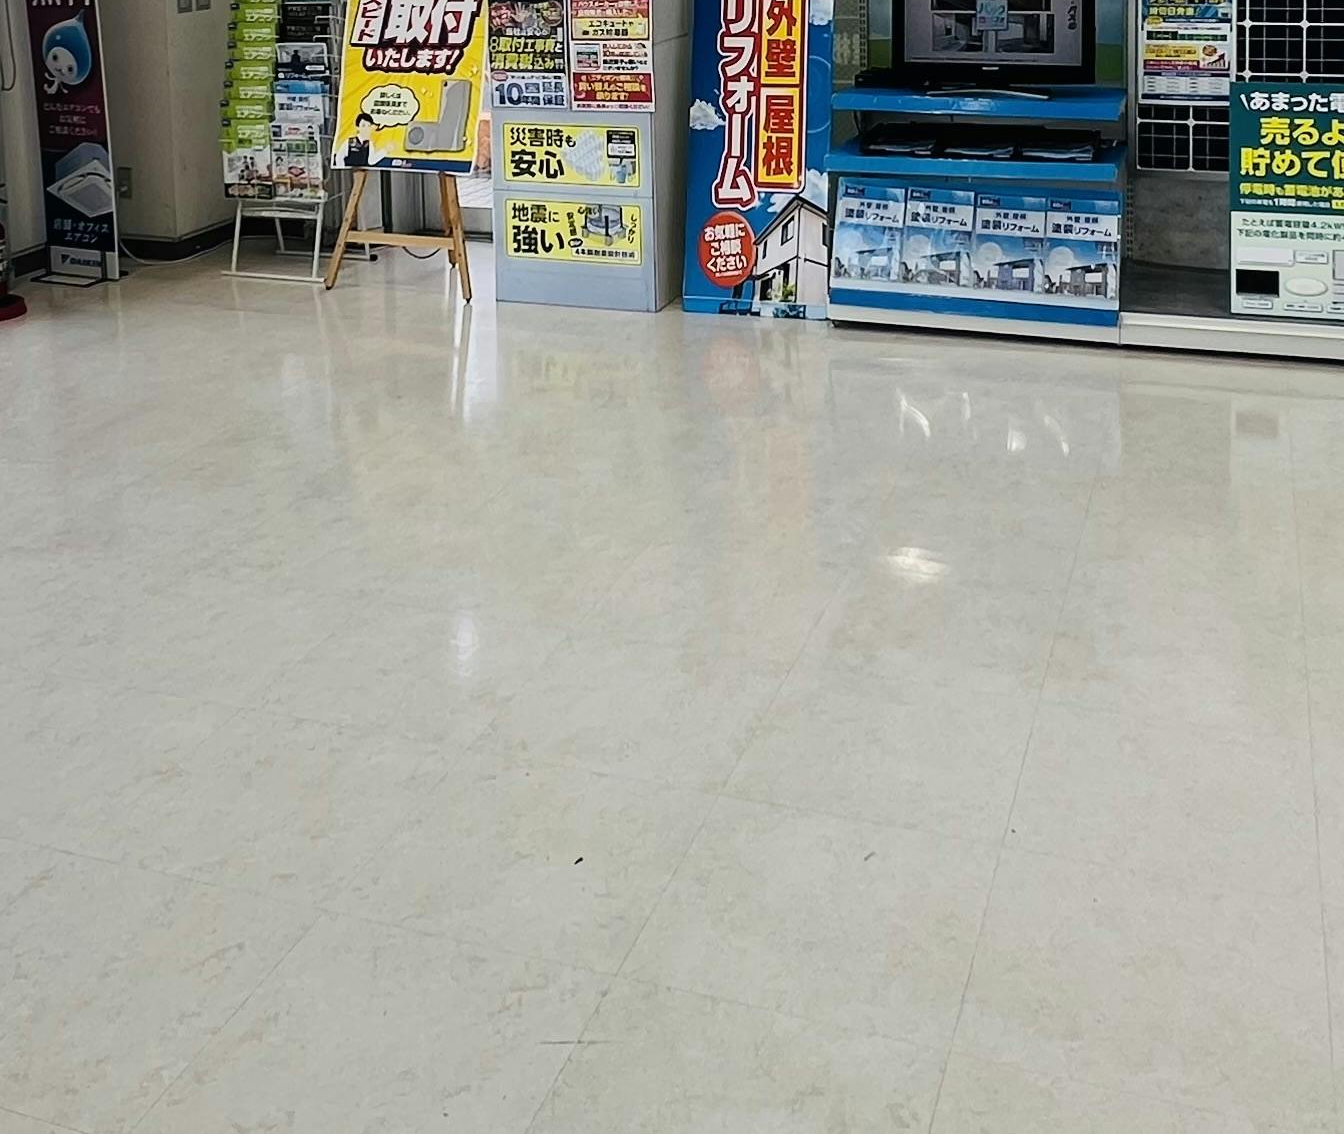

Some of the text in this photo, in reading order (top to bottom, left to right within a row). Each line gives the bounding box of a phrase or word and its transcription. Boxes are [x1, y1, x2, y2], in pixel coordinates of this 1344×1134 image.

[365, 48, 460, 70] いたします!
[510, 127, 577, 148] 災害時も
[762, 94, 795, 177] 屋根
[511, 149, 565, 179] 安心
[512, 203, 560, 224] 地震に
[65, 232, 98, 243] エアコン
[512, 225, 565, 254] 強い
[704, 223, 746, 242] お気軽に
[710, 239, 742, 257] ご相談
[706, 255, 748, 273] ください
